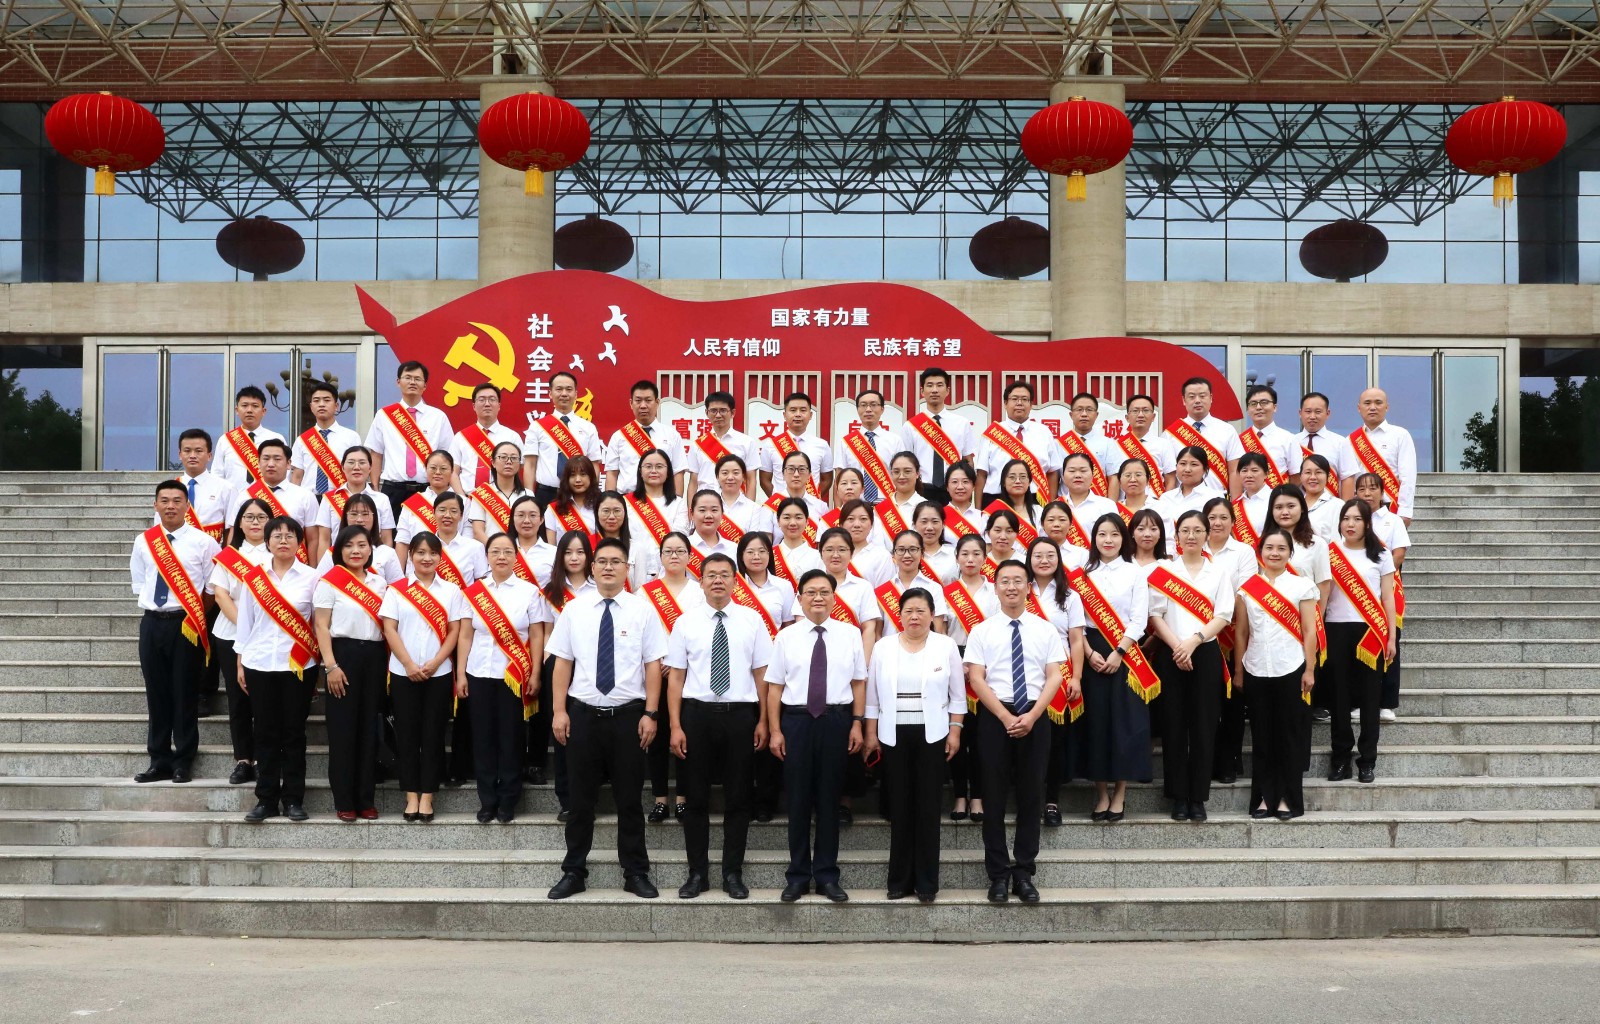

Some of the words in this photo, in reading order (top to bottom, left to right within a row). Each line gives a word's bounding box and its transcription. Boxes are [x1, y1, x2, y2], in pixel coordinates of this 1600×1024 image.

[771, 307, 870, 327] 国家有力量
[683, 338, 781, 357] 人民有信仰
[863, 338, 962, 357] 民族有希望
